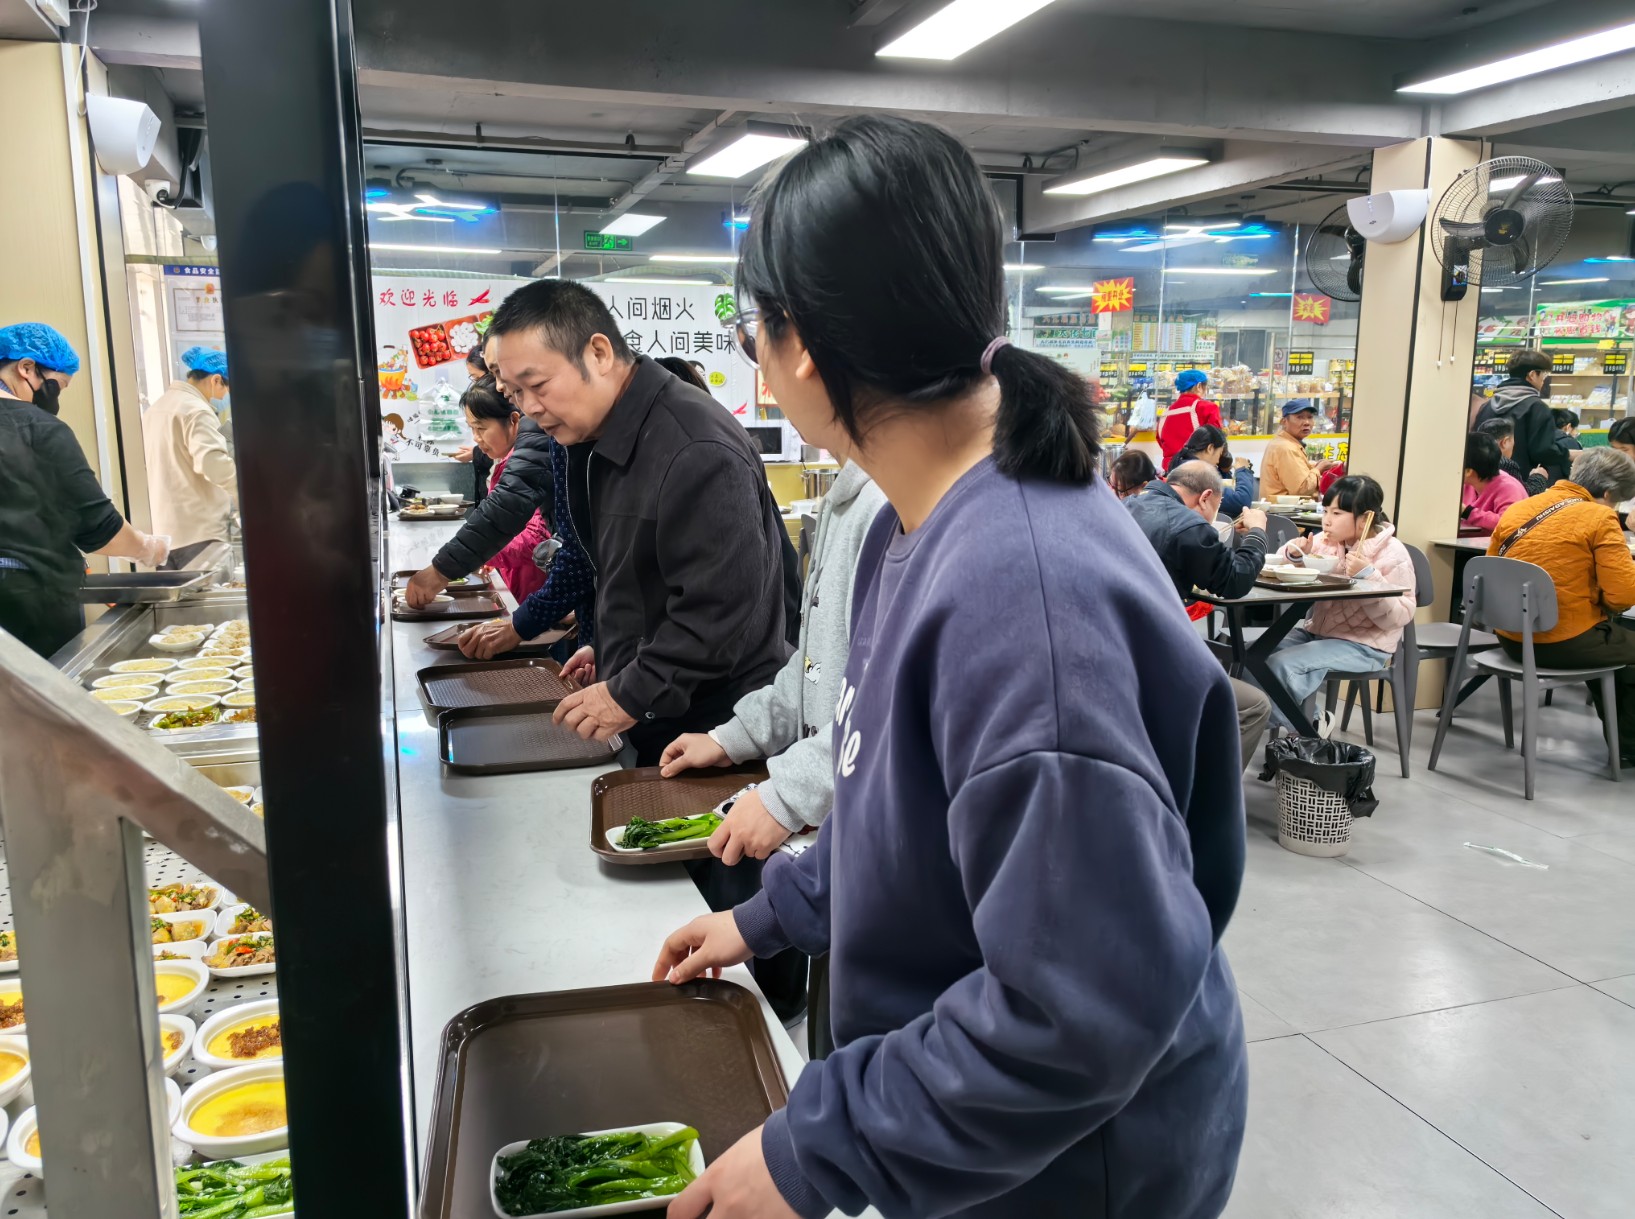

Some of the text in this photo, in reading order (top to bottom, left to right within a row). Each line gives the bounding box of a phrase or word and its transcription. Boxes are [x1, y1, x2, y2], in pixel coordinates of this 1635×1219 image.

[379, 288, 459, 308] 欢迎光临
[608, 295, 695, 321] 人间烟火
[623, 329, 736, 355] 食人间美味
